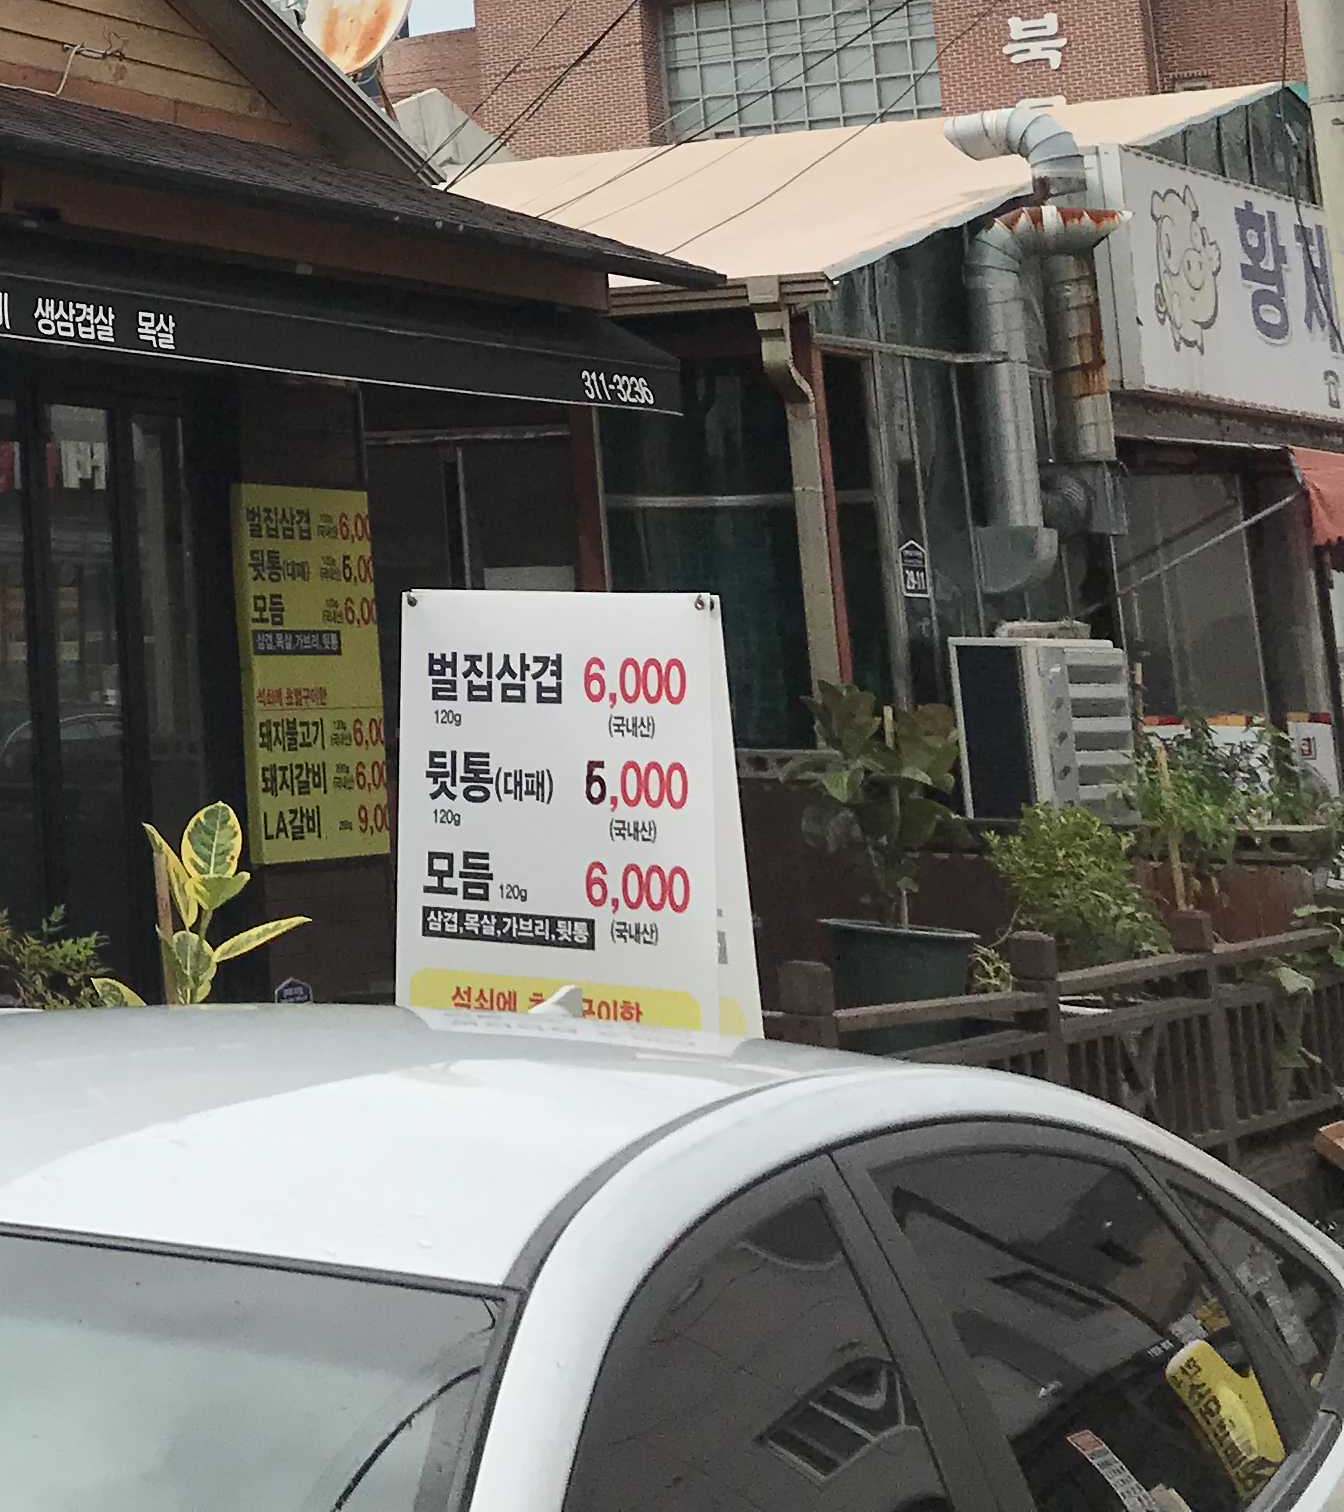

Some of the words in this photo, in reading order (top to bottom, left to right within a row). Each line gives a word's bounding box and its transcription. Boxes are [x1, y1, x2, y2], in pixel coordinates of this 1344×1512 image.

[34, 297, 114, 344] 생삼겹살
[137, 311, 175, 350] 목살
[581, 370, 654, 405] 311-3236
[247, 506, 311, 540] 벌집삼겹
[251, 593, 285, 625] 모듬
[427, 652, 563, 705] 벌집삼겹
[584, 657, 687, 708] 6,000
[259, 718, 325, 751] 돼지불고기
[434, 709, 462, 727] 120g
[608, 715, 655, 739] (국내산)
[262, 761, 327, 796] 돼지갈비
[264, 805, 322, 840] LA갈비
[432, 809, 461, 827] 120g
[609, 819, 657, 843] (국내산)
[423, 851, 494, 902] 모듬
[499, 883, 528, 903] 120g
[584, 861, 690, 914] 6,000
[611, 921, 659, 947] (국내산)
[451, 986, 517, 1013] 석쇠에
